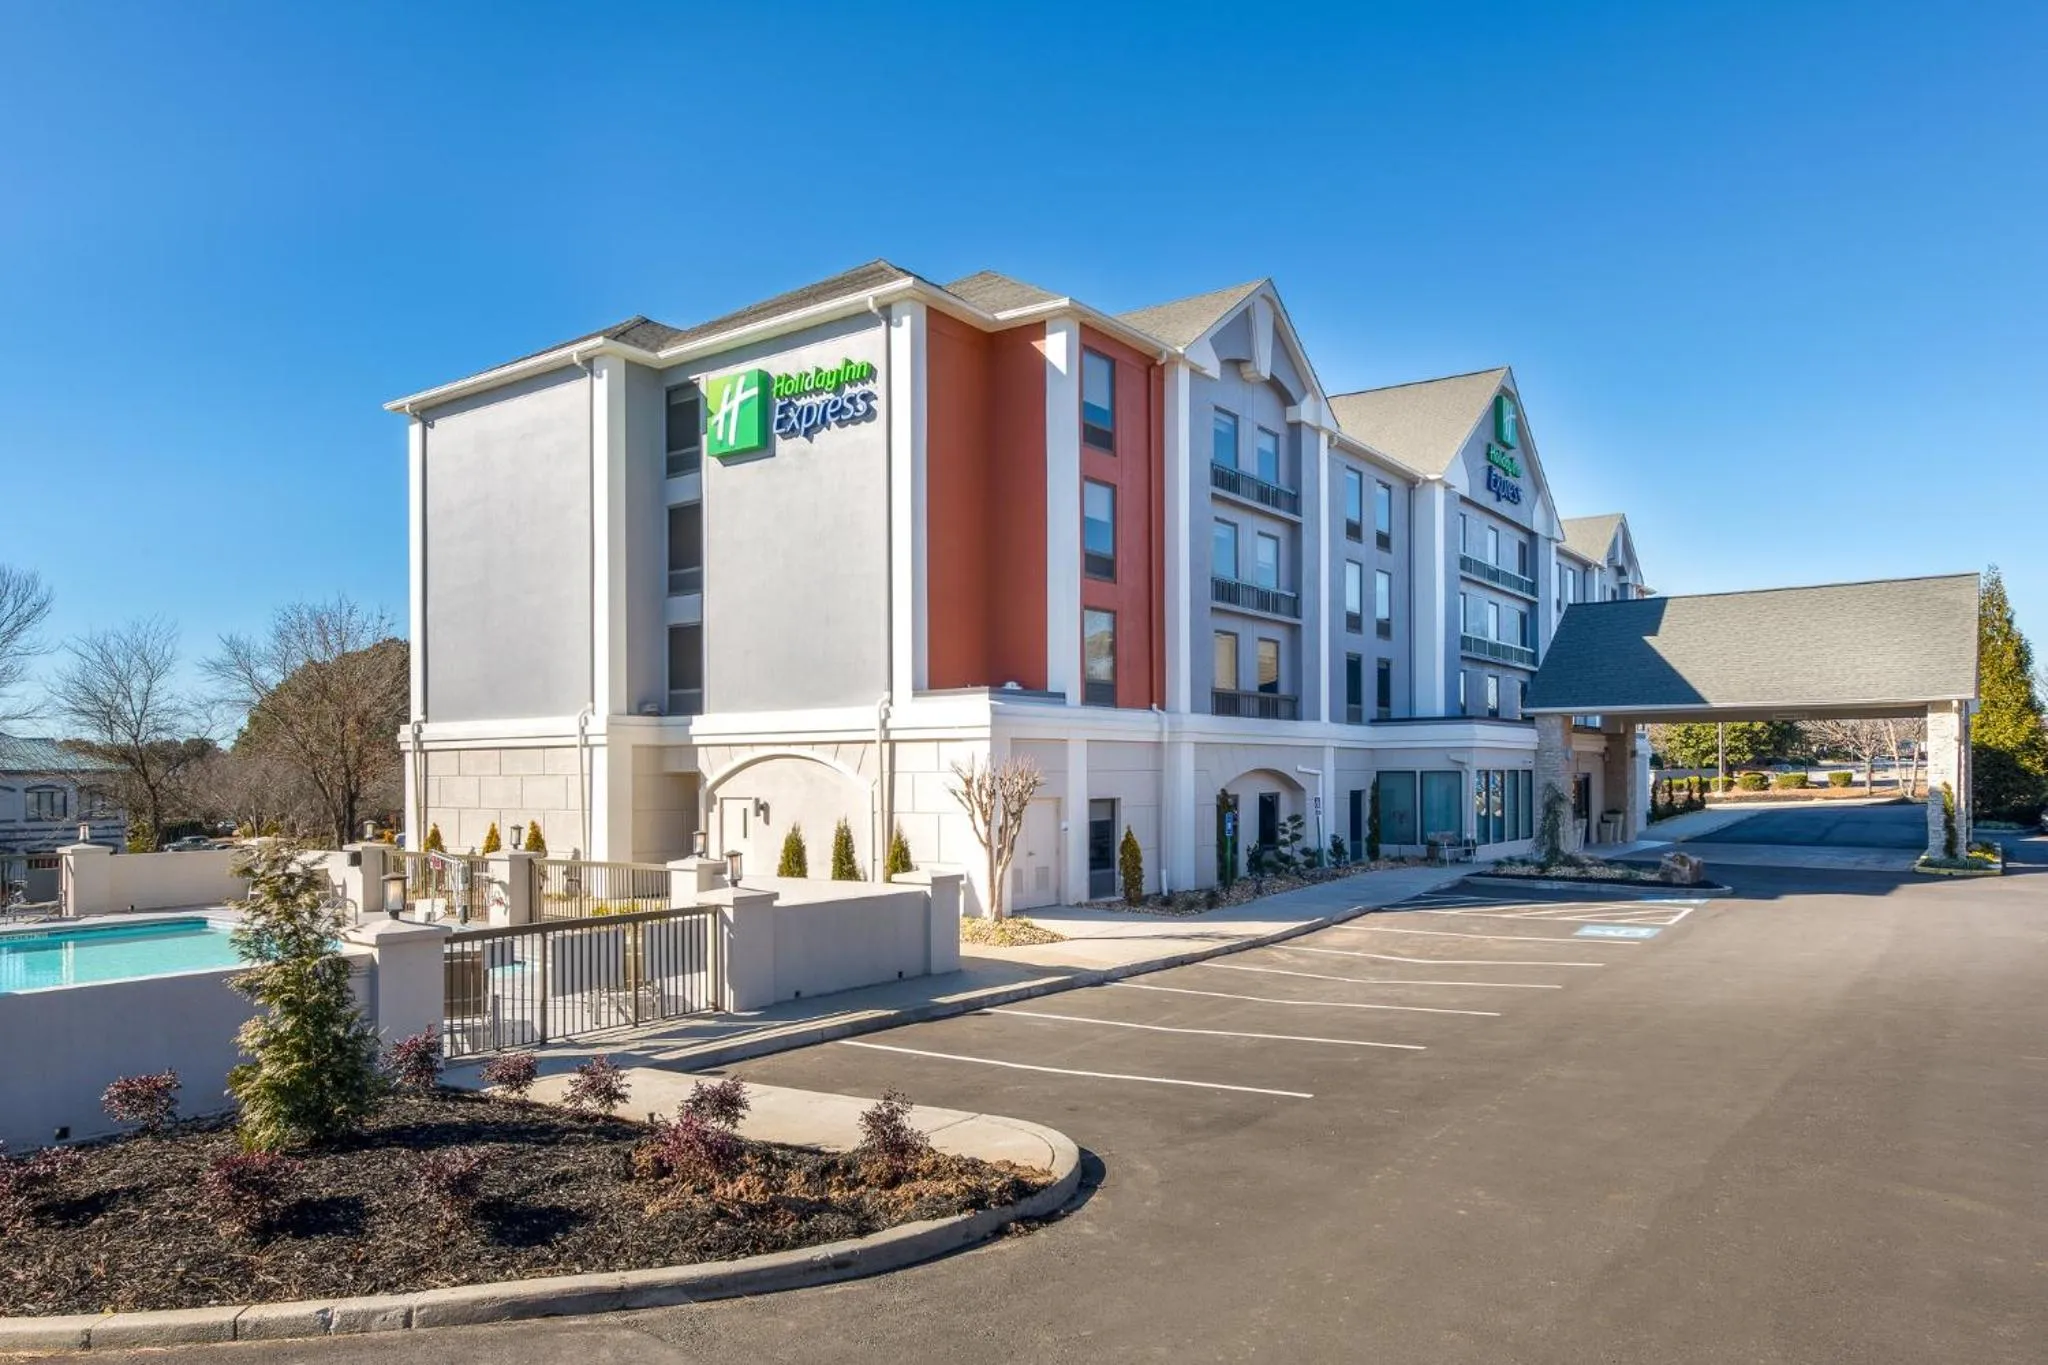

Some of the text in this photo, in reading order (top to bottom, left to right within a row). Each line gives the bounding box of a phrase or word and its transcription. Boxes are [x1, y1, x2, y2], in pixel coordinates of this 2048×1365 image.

[773, 357, 871, 398] Holiday Inn
[772, 388, 872, 437] Express
